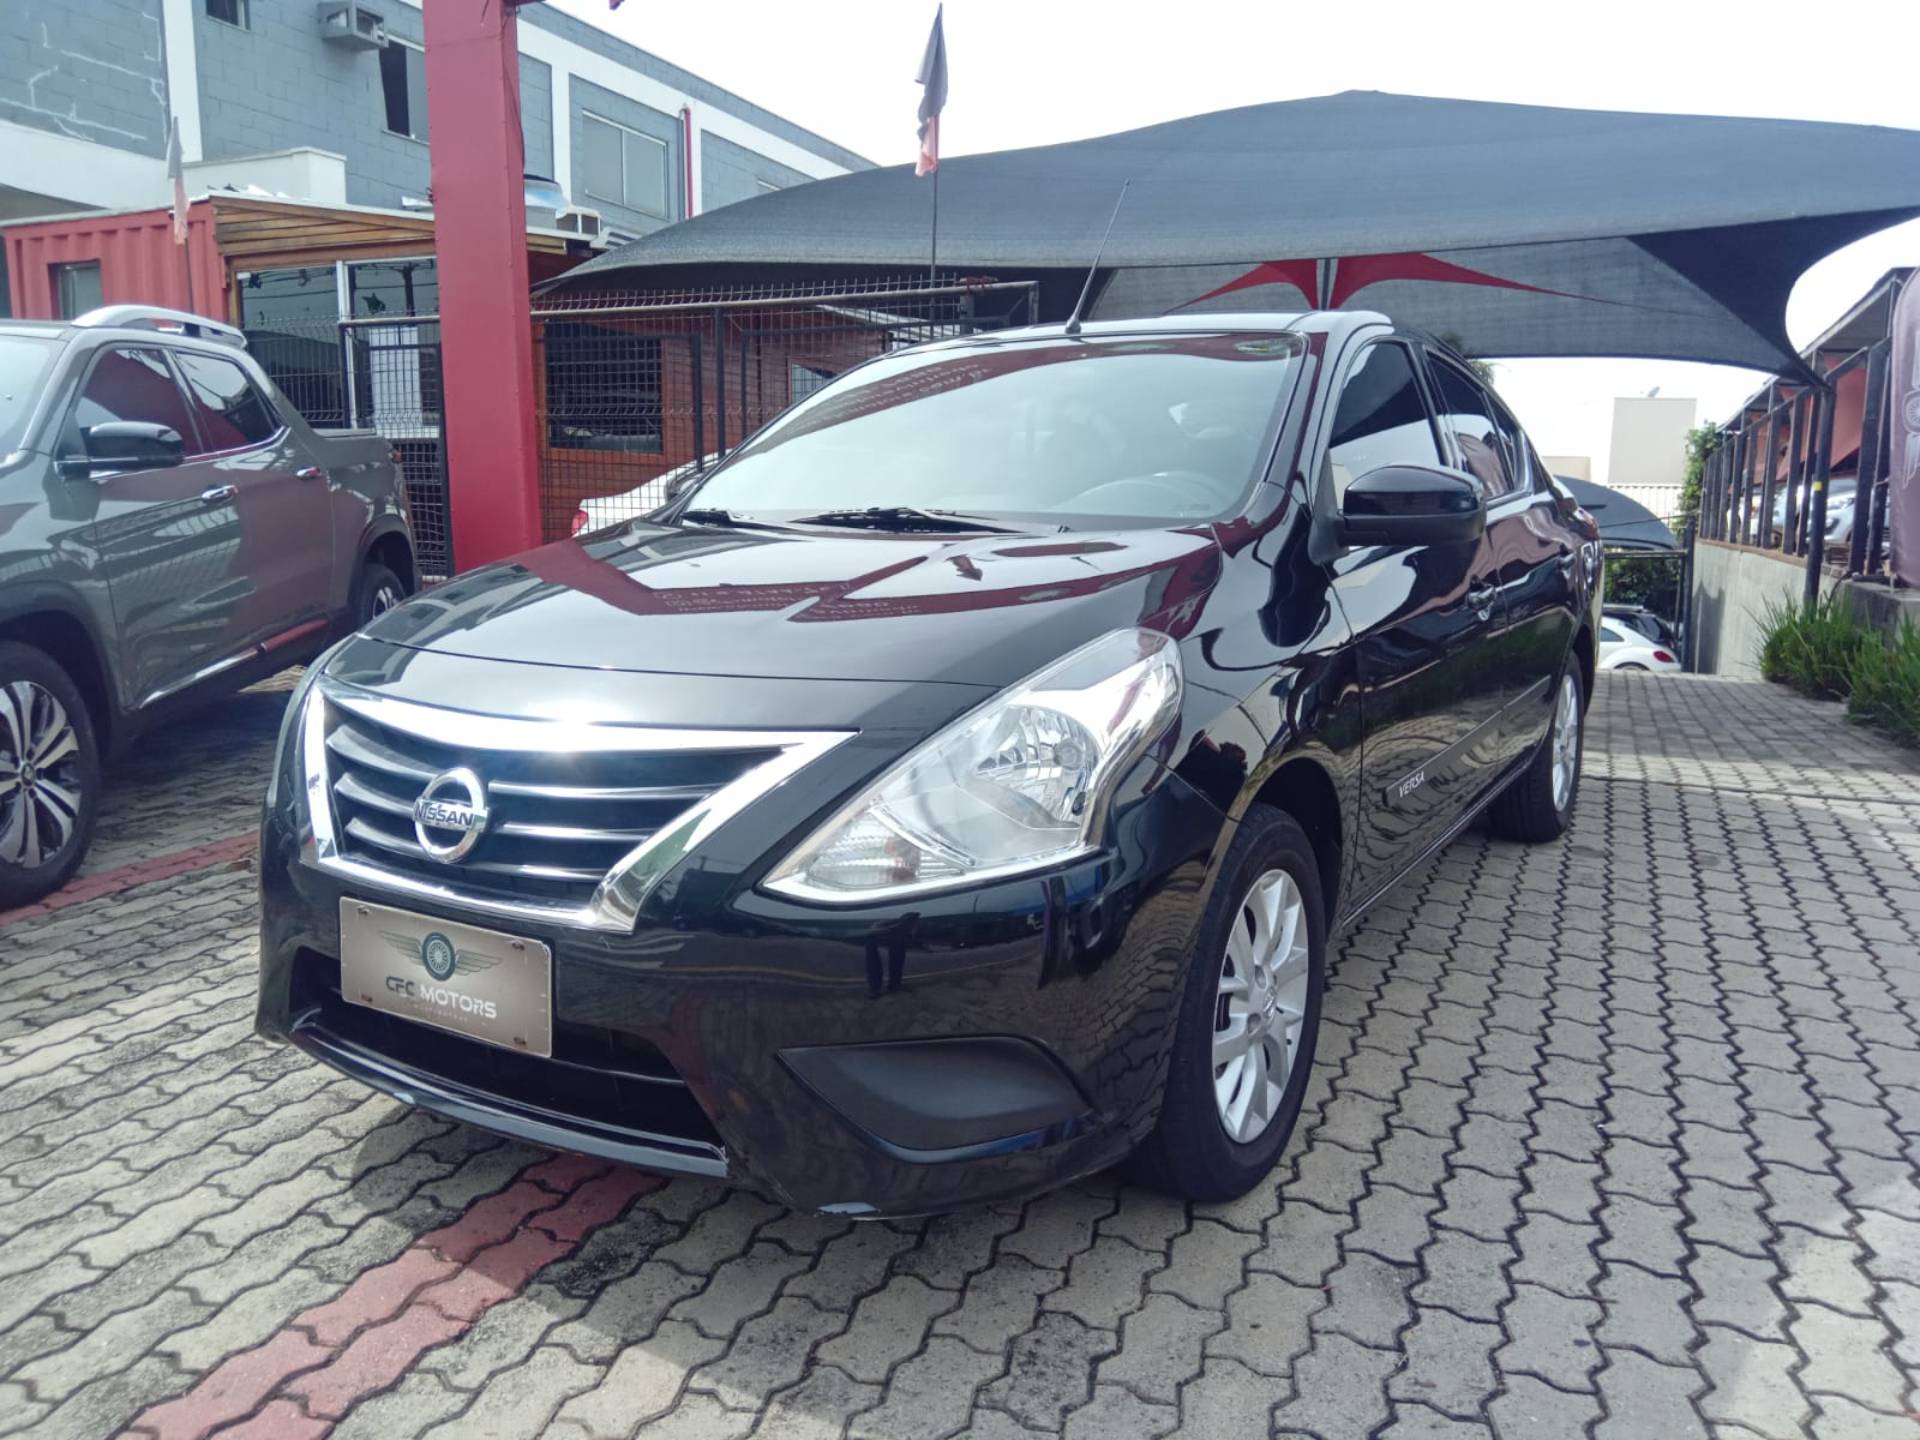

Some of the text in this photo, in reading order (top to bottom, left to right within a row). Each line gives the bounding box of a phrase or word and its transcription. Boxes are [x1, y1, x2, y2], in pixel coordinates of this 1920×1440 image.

[415, 803, 474, 826] NISSAN
[386, 976, 415, 997] CFC
[419, 983, 497, 1019] MOTORS
